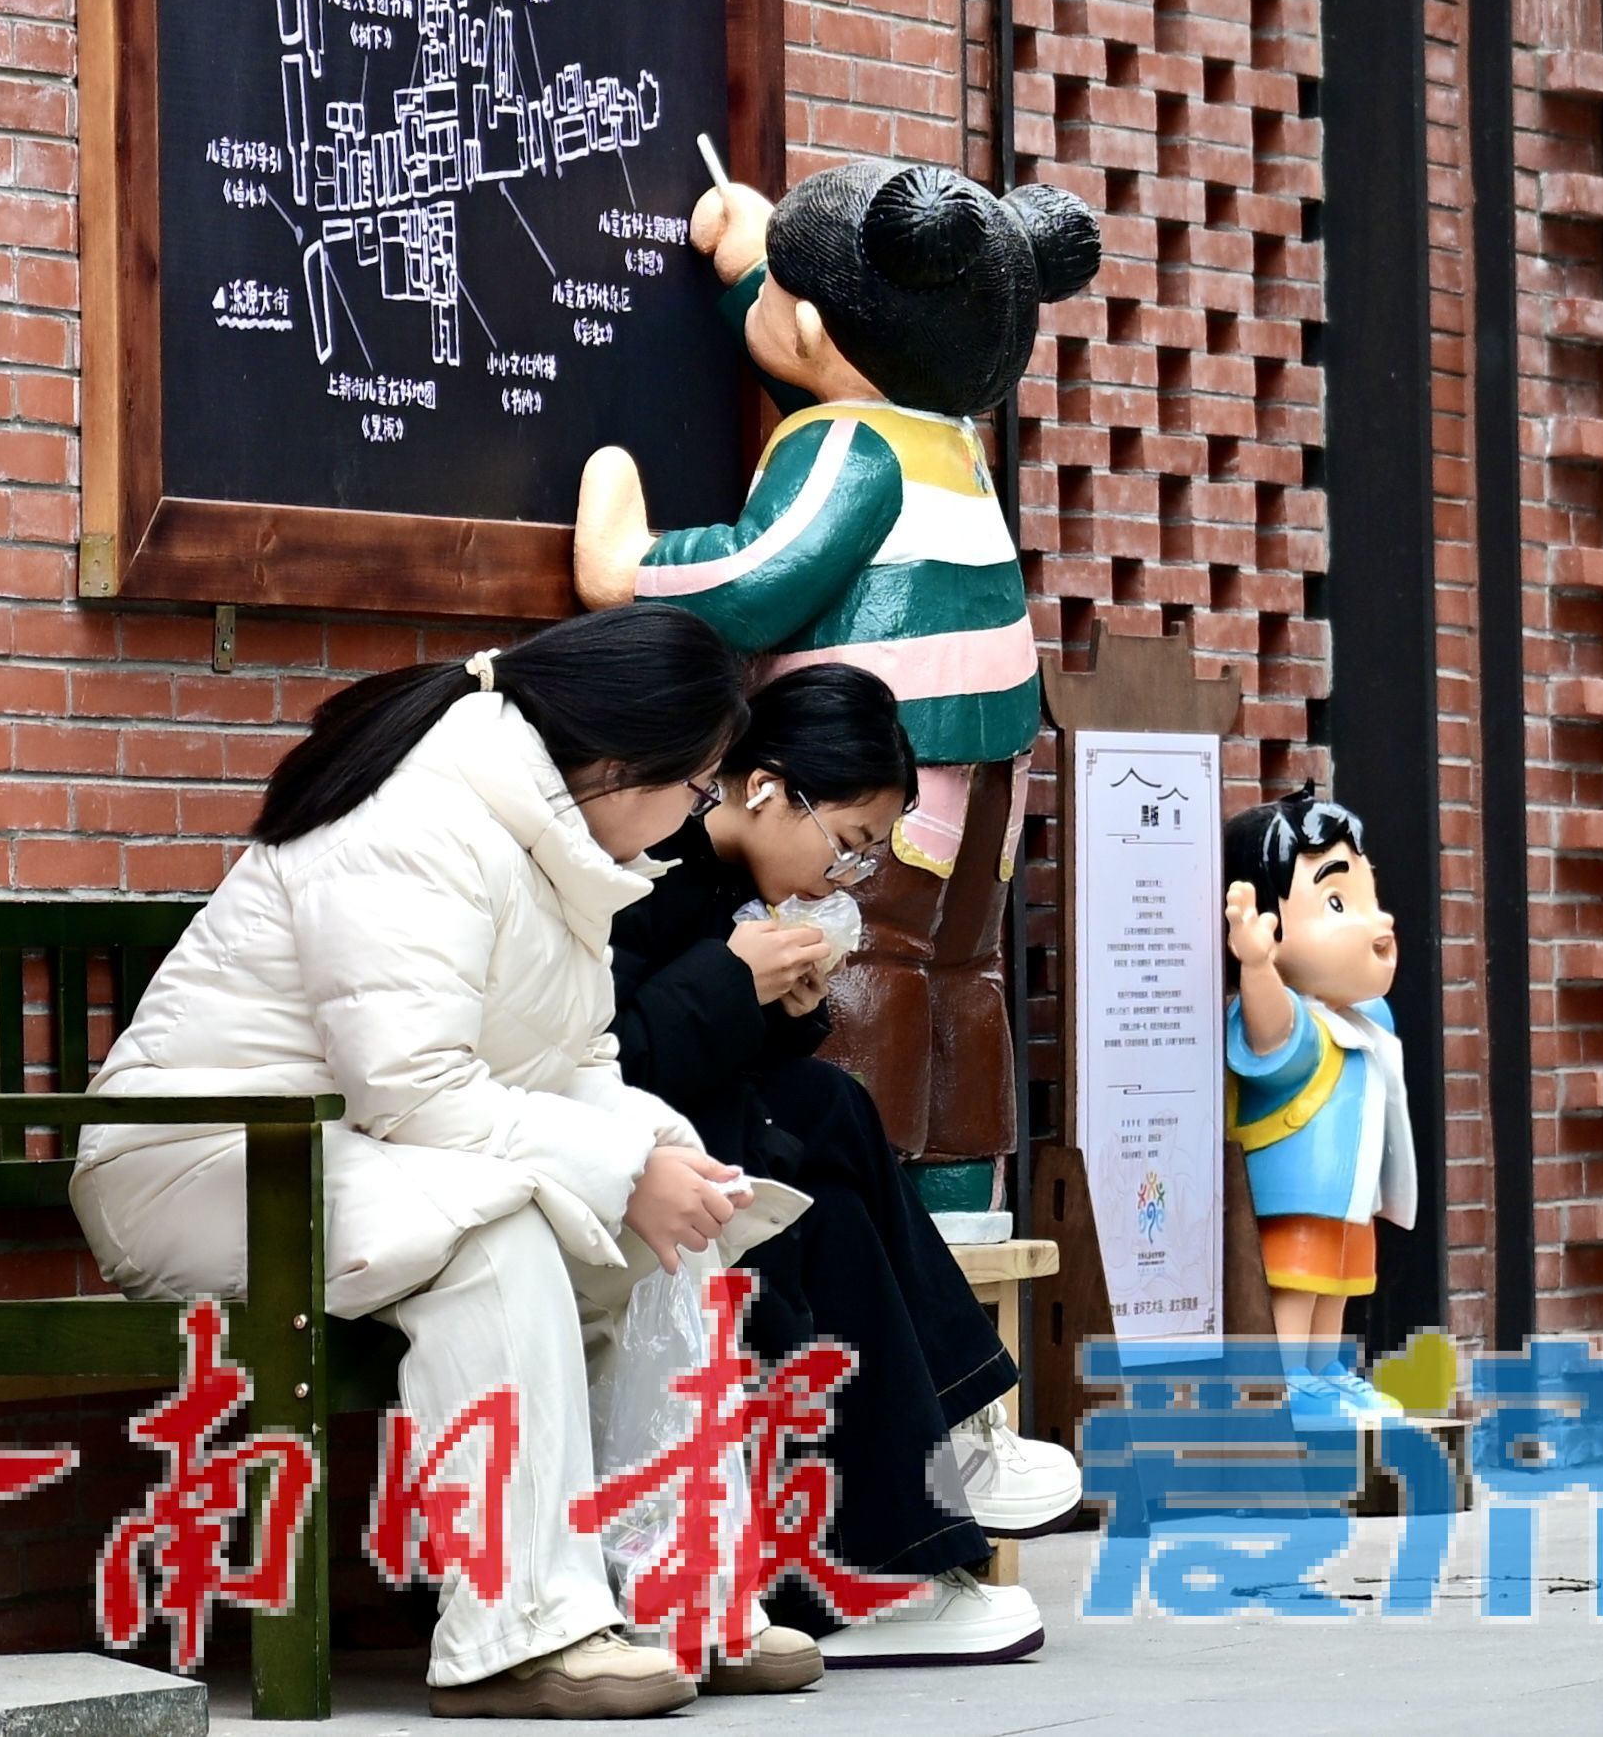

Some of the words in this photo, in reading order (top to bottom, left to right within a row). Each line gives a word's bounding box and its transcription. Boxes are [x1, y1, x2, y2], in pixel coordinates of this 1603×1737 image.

[326, 371, 437, 410] 上新街儿童友好地图
